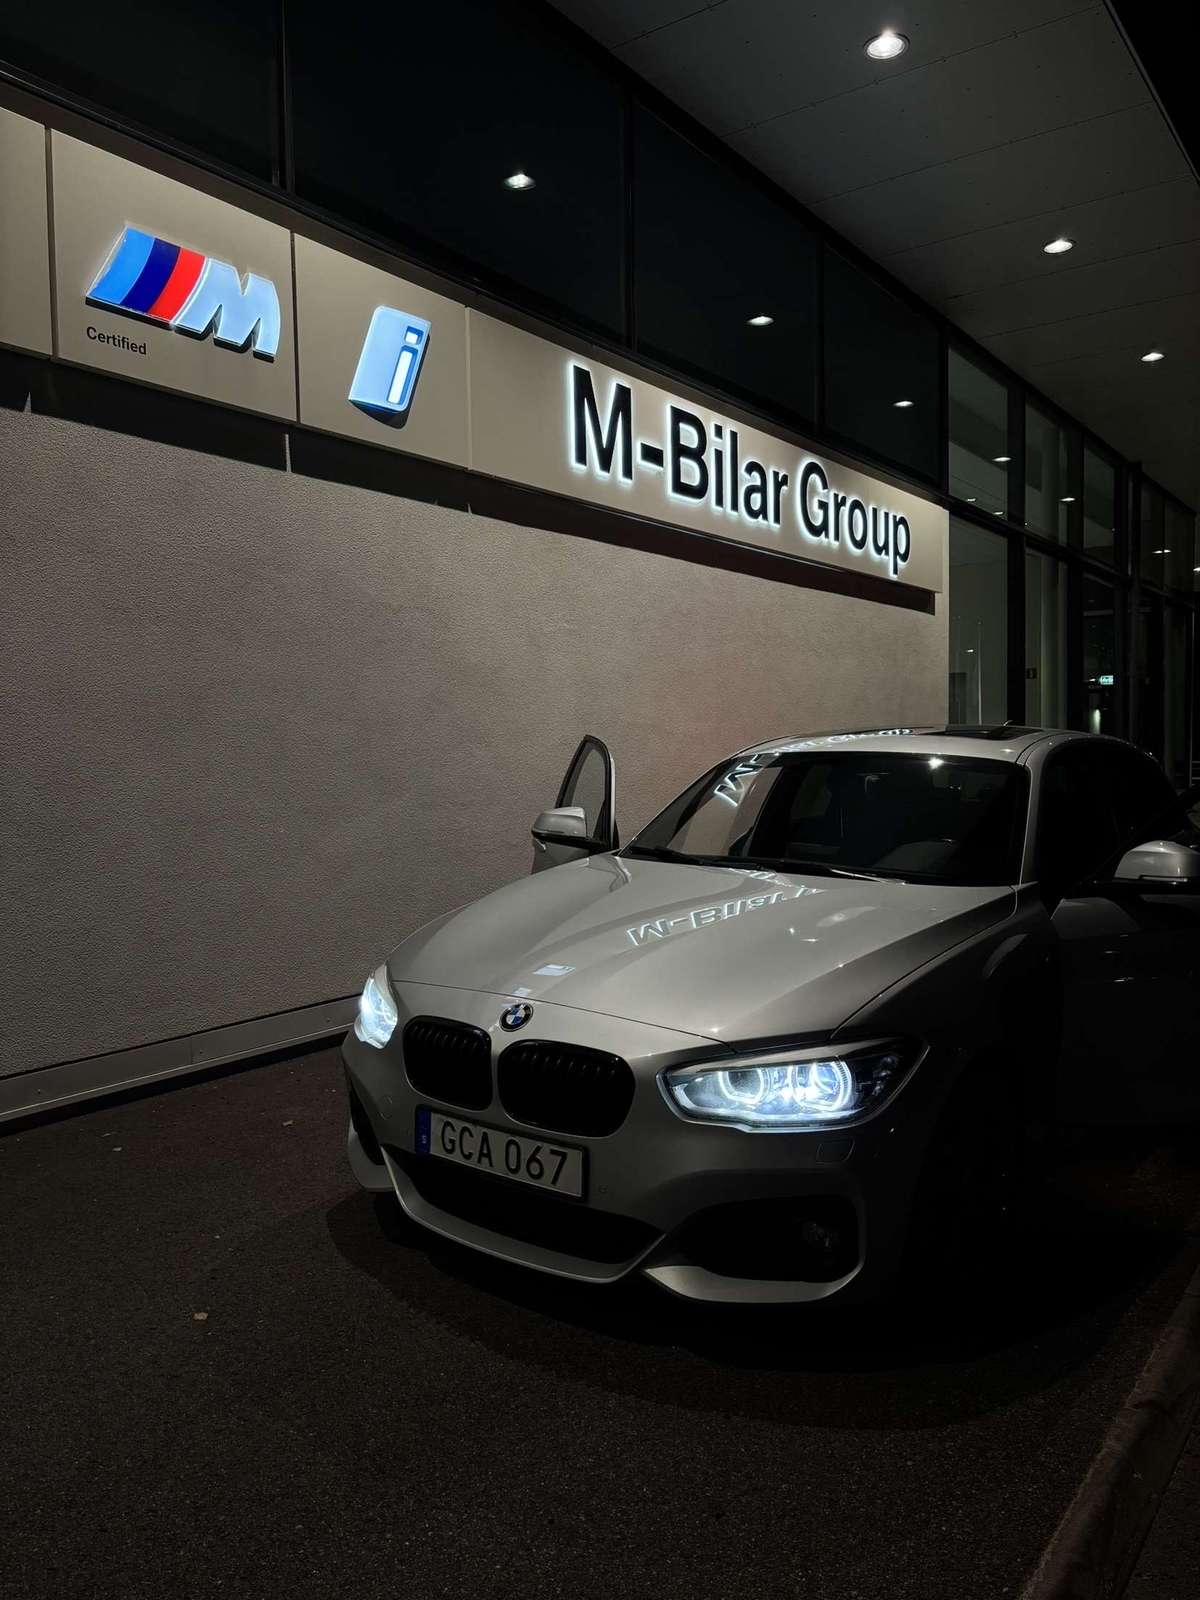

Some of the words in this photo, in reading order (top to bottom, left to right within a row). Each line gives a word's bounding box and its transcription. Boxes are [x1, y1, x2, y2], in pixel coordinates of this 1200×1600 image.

[86, 325, 147, 356] Certified
[173, 257, 281, 358] M
[572, 363, 788, 526] M-Bilar
[800, 460, 912, 576] Group
[421, 1134, 428, 1145] S
[440, 1119, 494, 1168] GCA
[504, 1138, 568, 1186] 067
